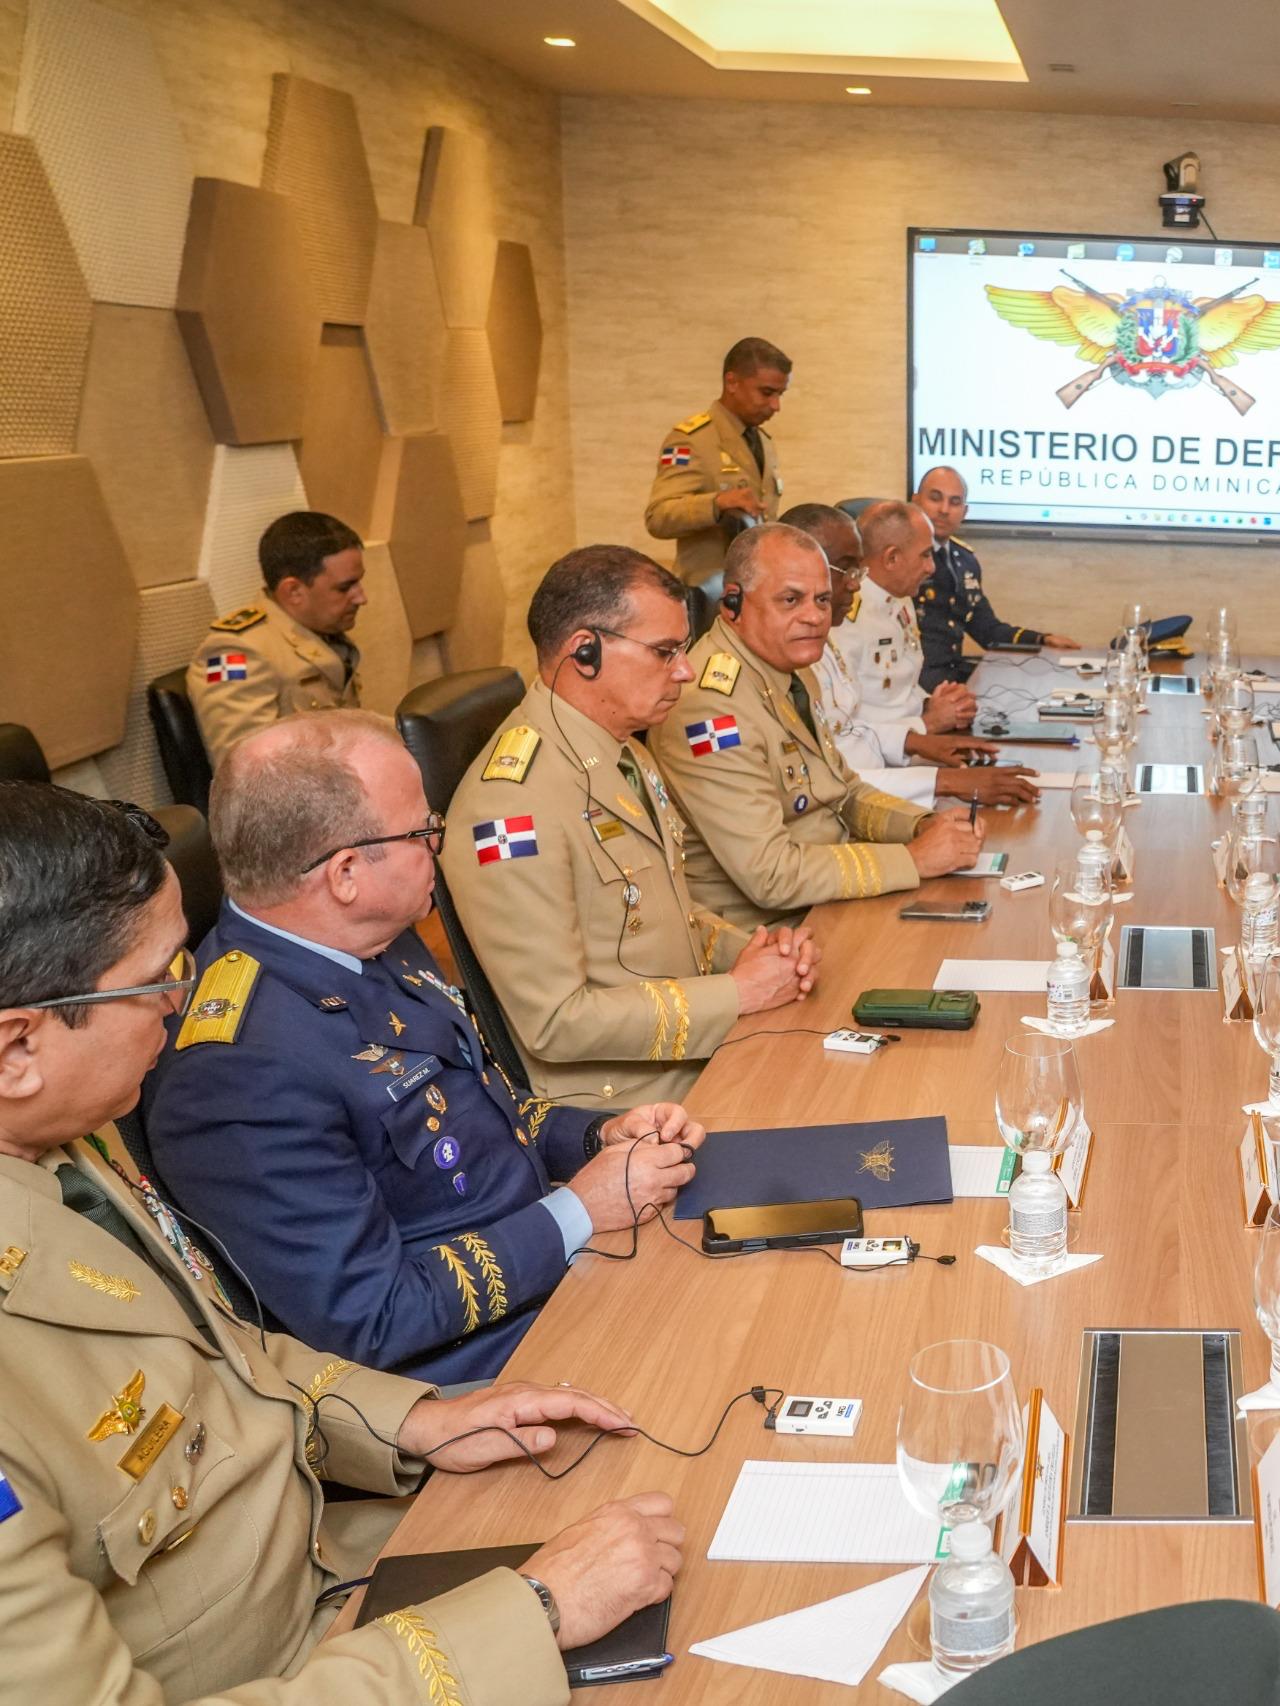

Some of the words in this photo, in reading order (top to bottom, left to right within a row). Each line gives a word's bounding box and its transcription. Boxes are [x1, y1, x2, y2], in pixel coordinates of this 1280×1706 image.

[919, 427, 1138, 462] MINISTERIO
[1152, 435, 1201, 465] DE
[980, 466, 1138, 489] REPÚBLICA
[402, 1072, 425, 1089] SUAREZ
[138, 1420, 170, 1461] AGUILERA
